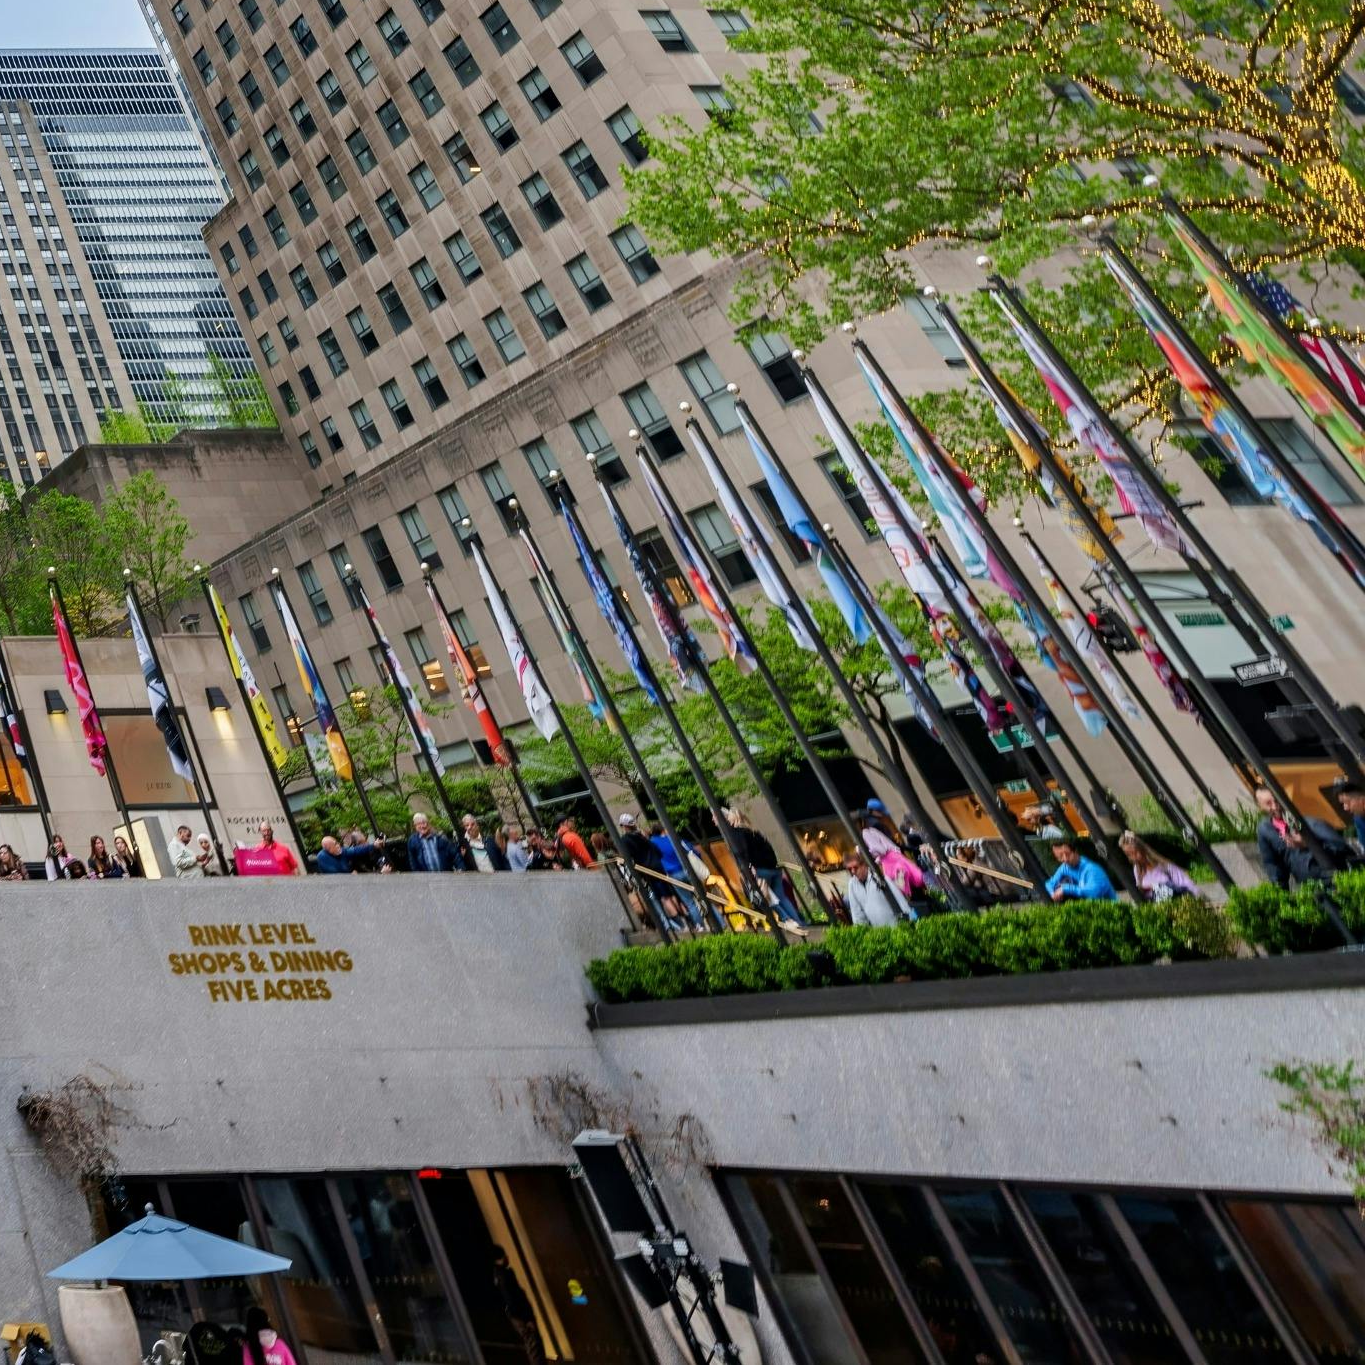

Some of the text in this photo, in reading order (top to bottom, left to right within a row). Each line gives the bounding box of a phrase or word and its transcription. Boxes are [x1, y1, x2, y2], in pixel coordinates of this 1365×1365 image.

[187, 923, 316, 947] RINK LEVEL
[167, 949, 354, 976] SHOPS & DINING
[207, 978, 333, 1003] FIVE ACRES
